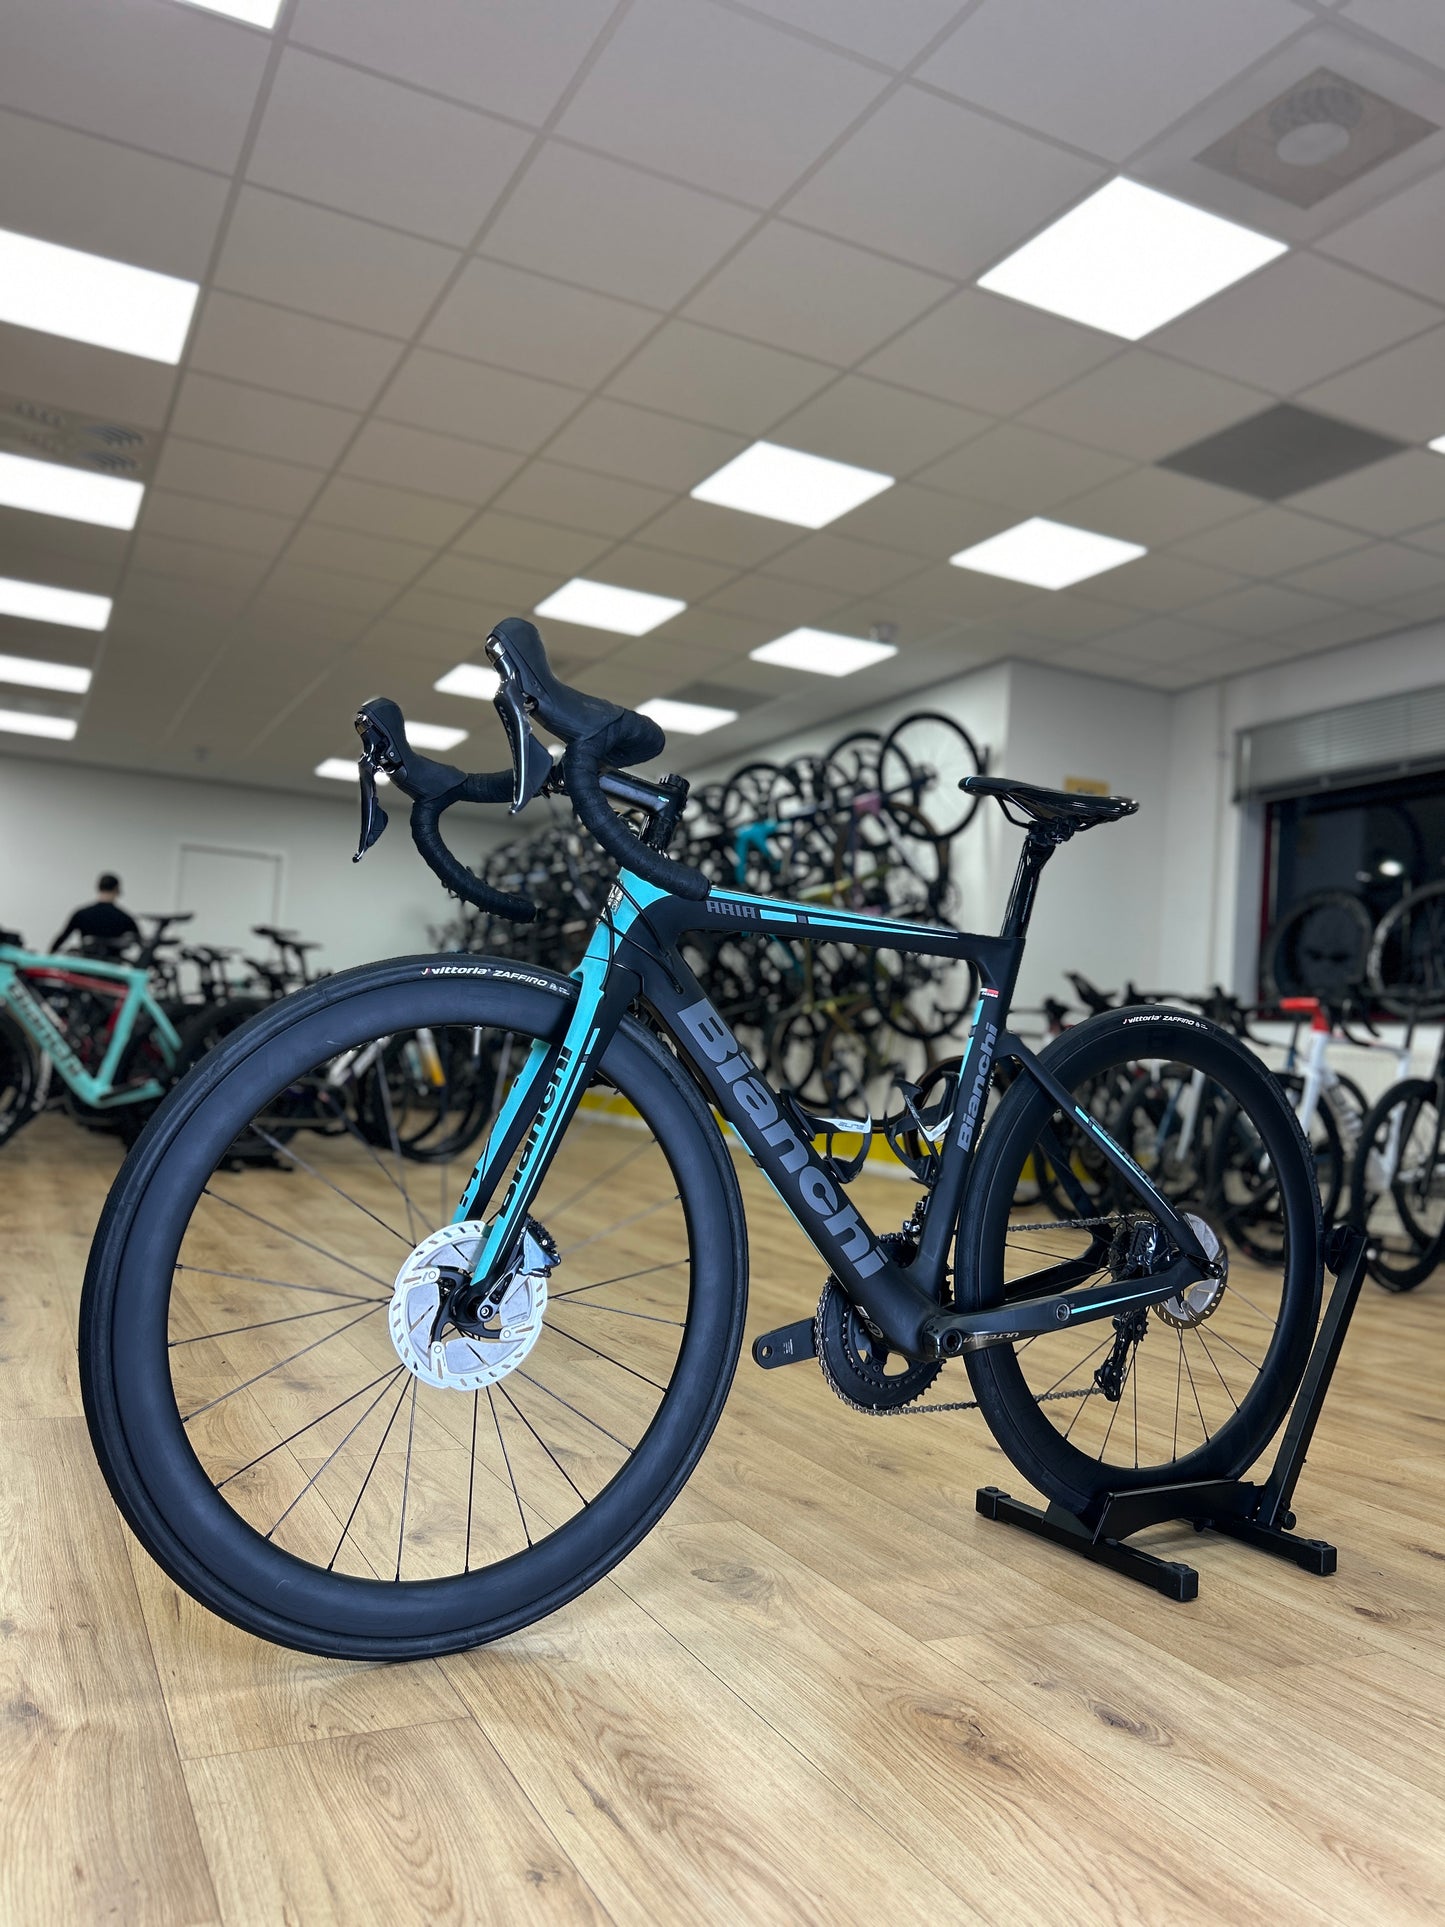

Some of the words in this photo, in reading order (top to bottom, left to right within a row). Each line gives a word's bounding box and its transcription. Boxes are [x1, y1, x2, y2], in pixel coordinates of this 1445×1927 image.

[706, 900, 756, 919] ARIA
[431, 966, 491, 975] vittoria
[493, 970, 548, 987] ZAFFIRO
[1128, 1015, 1161, 1024] vittoria
[1163, 1015, 1195, 1026] ZAFFIRO
[957, 1022, 998, 1153] Bianchi
[677, 997, 888, 1279] Bianchi
